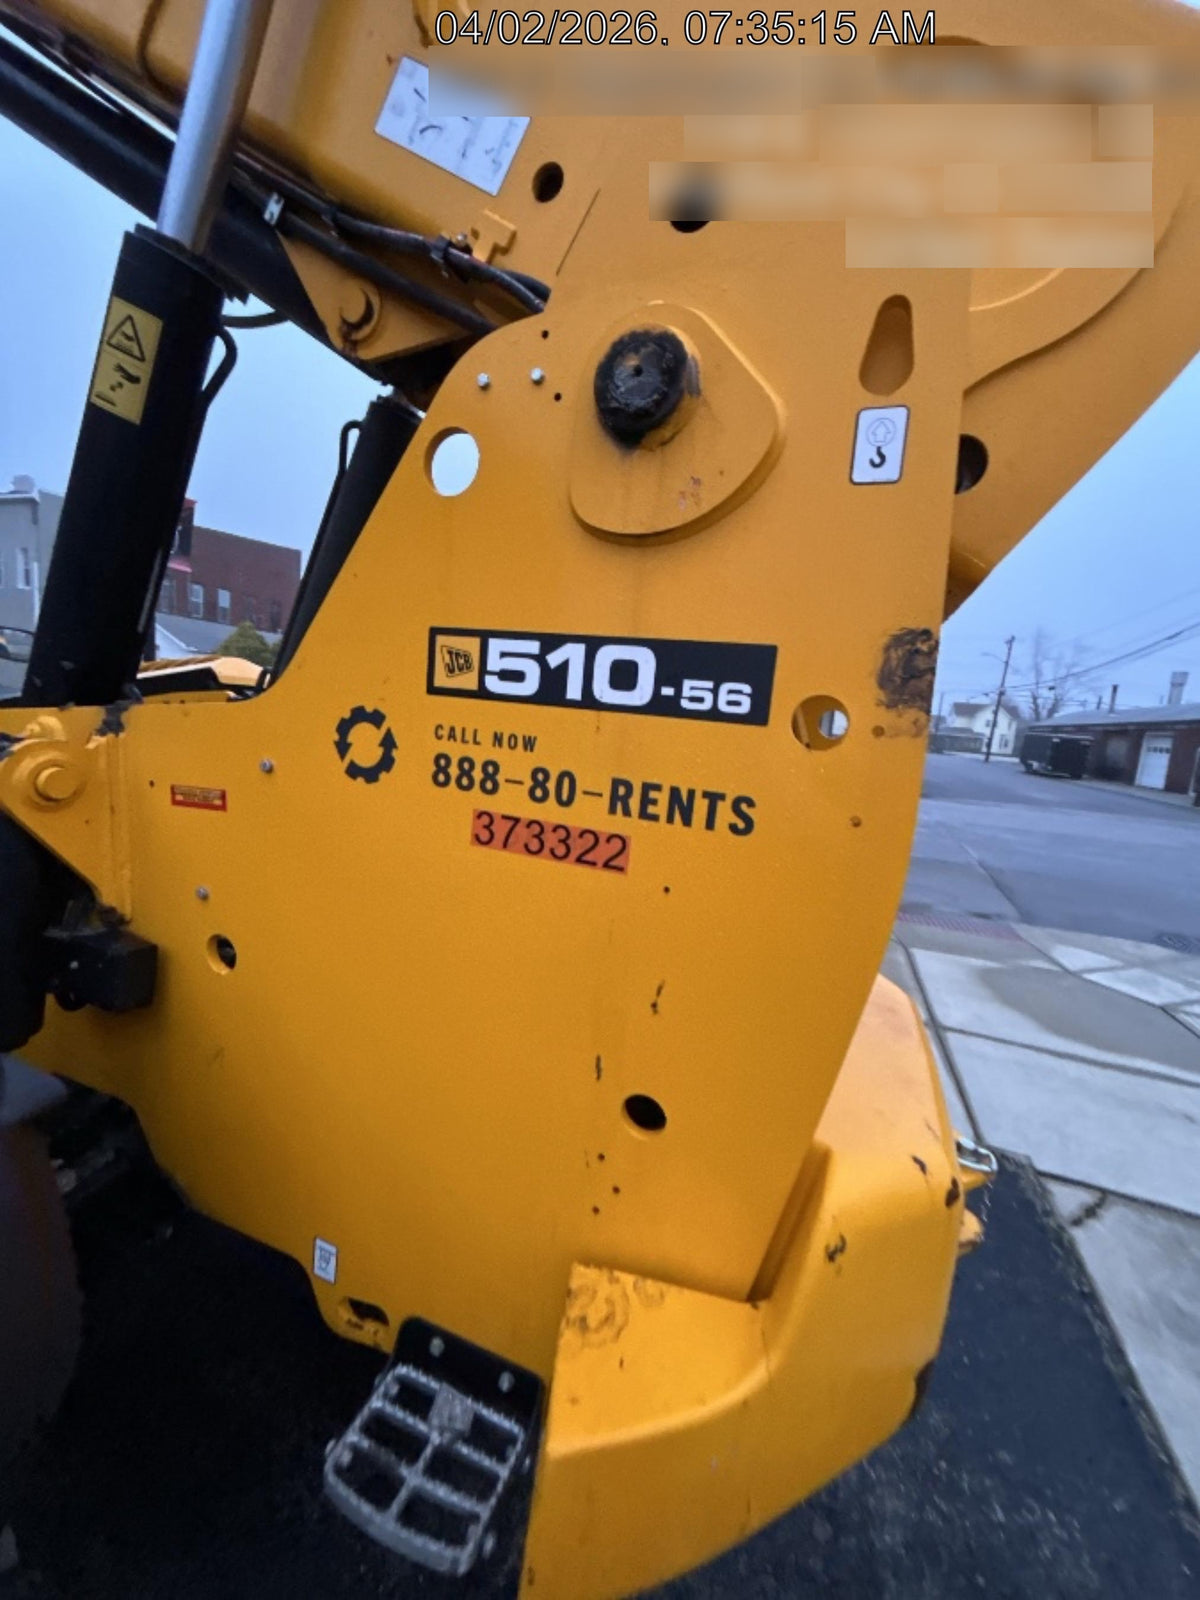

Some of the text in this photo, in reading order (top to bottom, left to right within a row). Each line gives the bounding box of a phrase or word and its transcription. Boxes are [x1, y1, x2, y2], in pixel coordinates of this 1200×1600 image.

[443, 647, 474, 676] JCB
[485, 637, 753, 715] 510-56
[434, 723, 538, 753] CALL NOW
[432, 752, 757, 837] 888-80-RENTS
[474, 810, 627, 873] 373322
